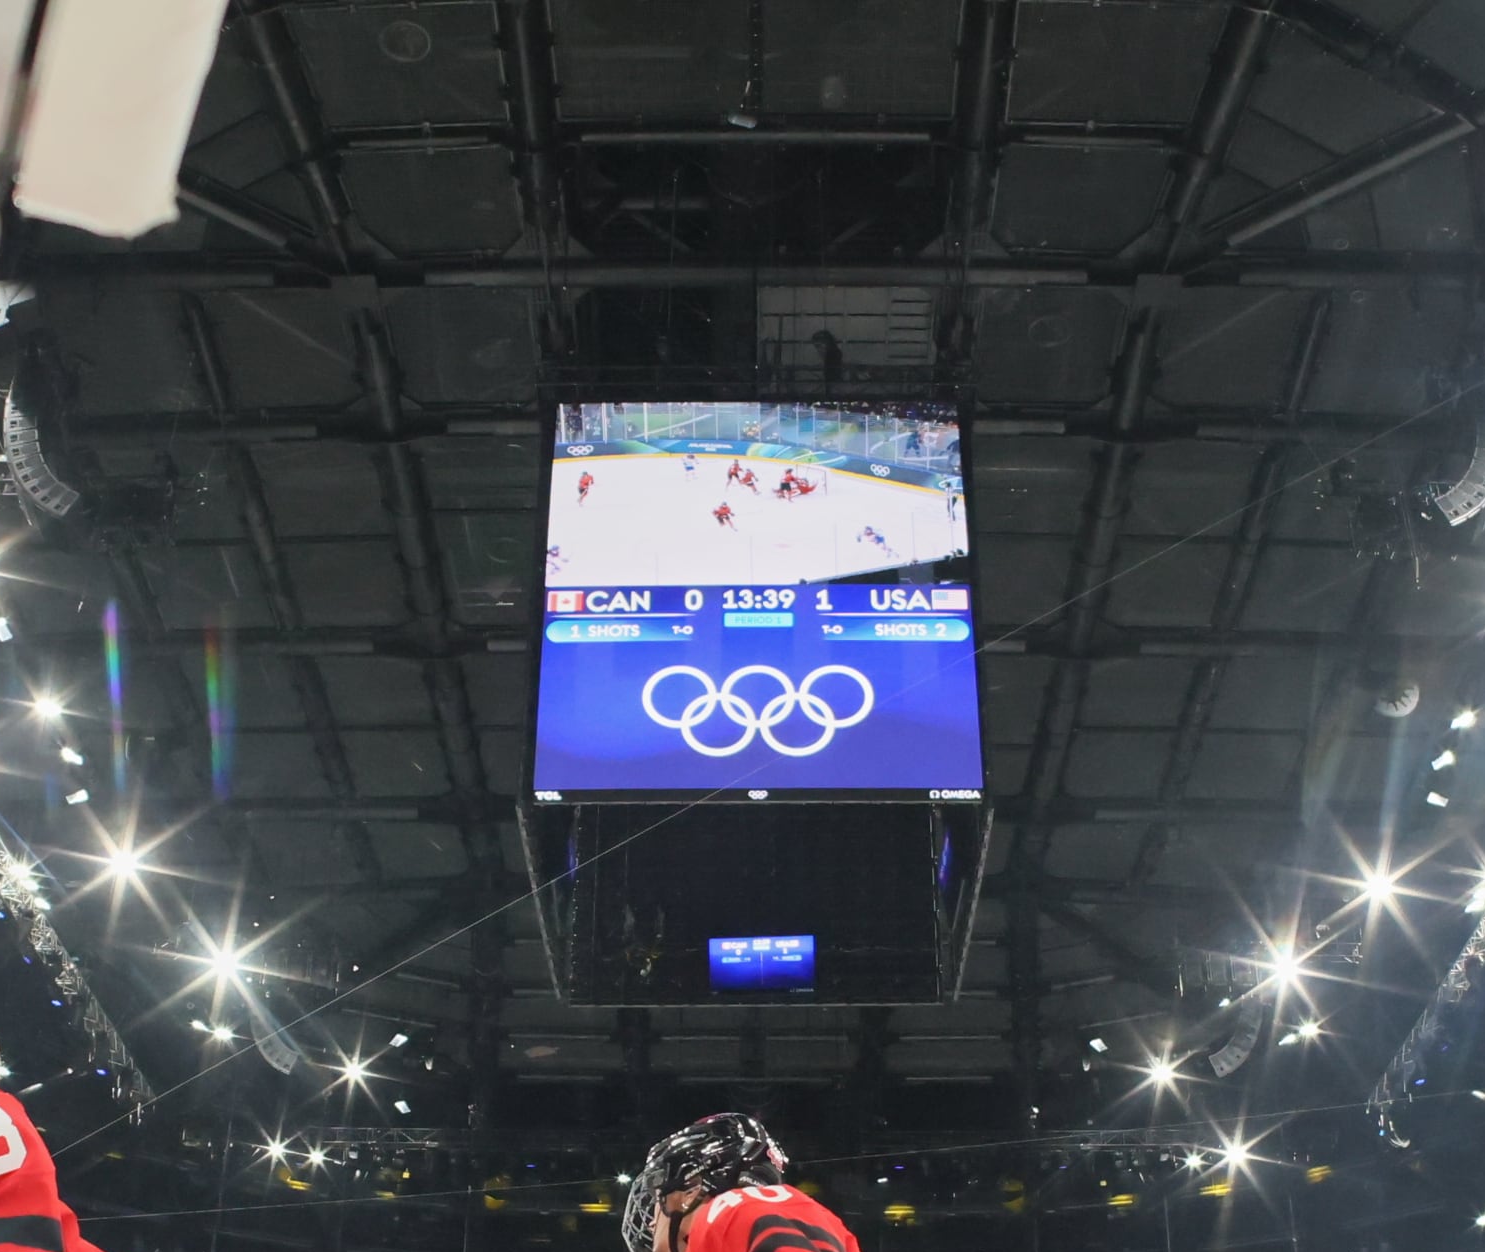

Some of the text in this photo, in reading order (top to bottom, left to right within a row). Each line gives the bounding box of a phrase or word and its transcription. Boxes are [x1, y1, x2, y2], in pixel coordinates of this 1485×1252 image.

[585, 588, 932, 613] CAN 0 13:39 1 USA
[570, 623, 641, 639] 1 SHOTS
[874, 622, 948, 638] SHOTS 2
